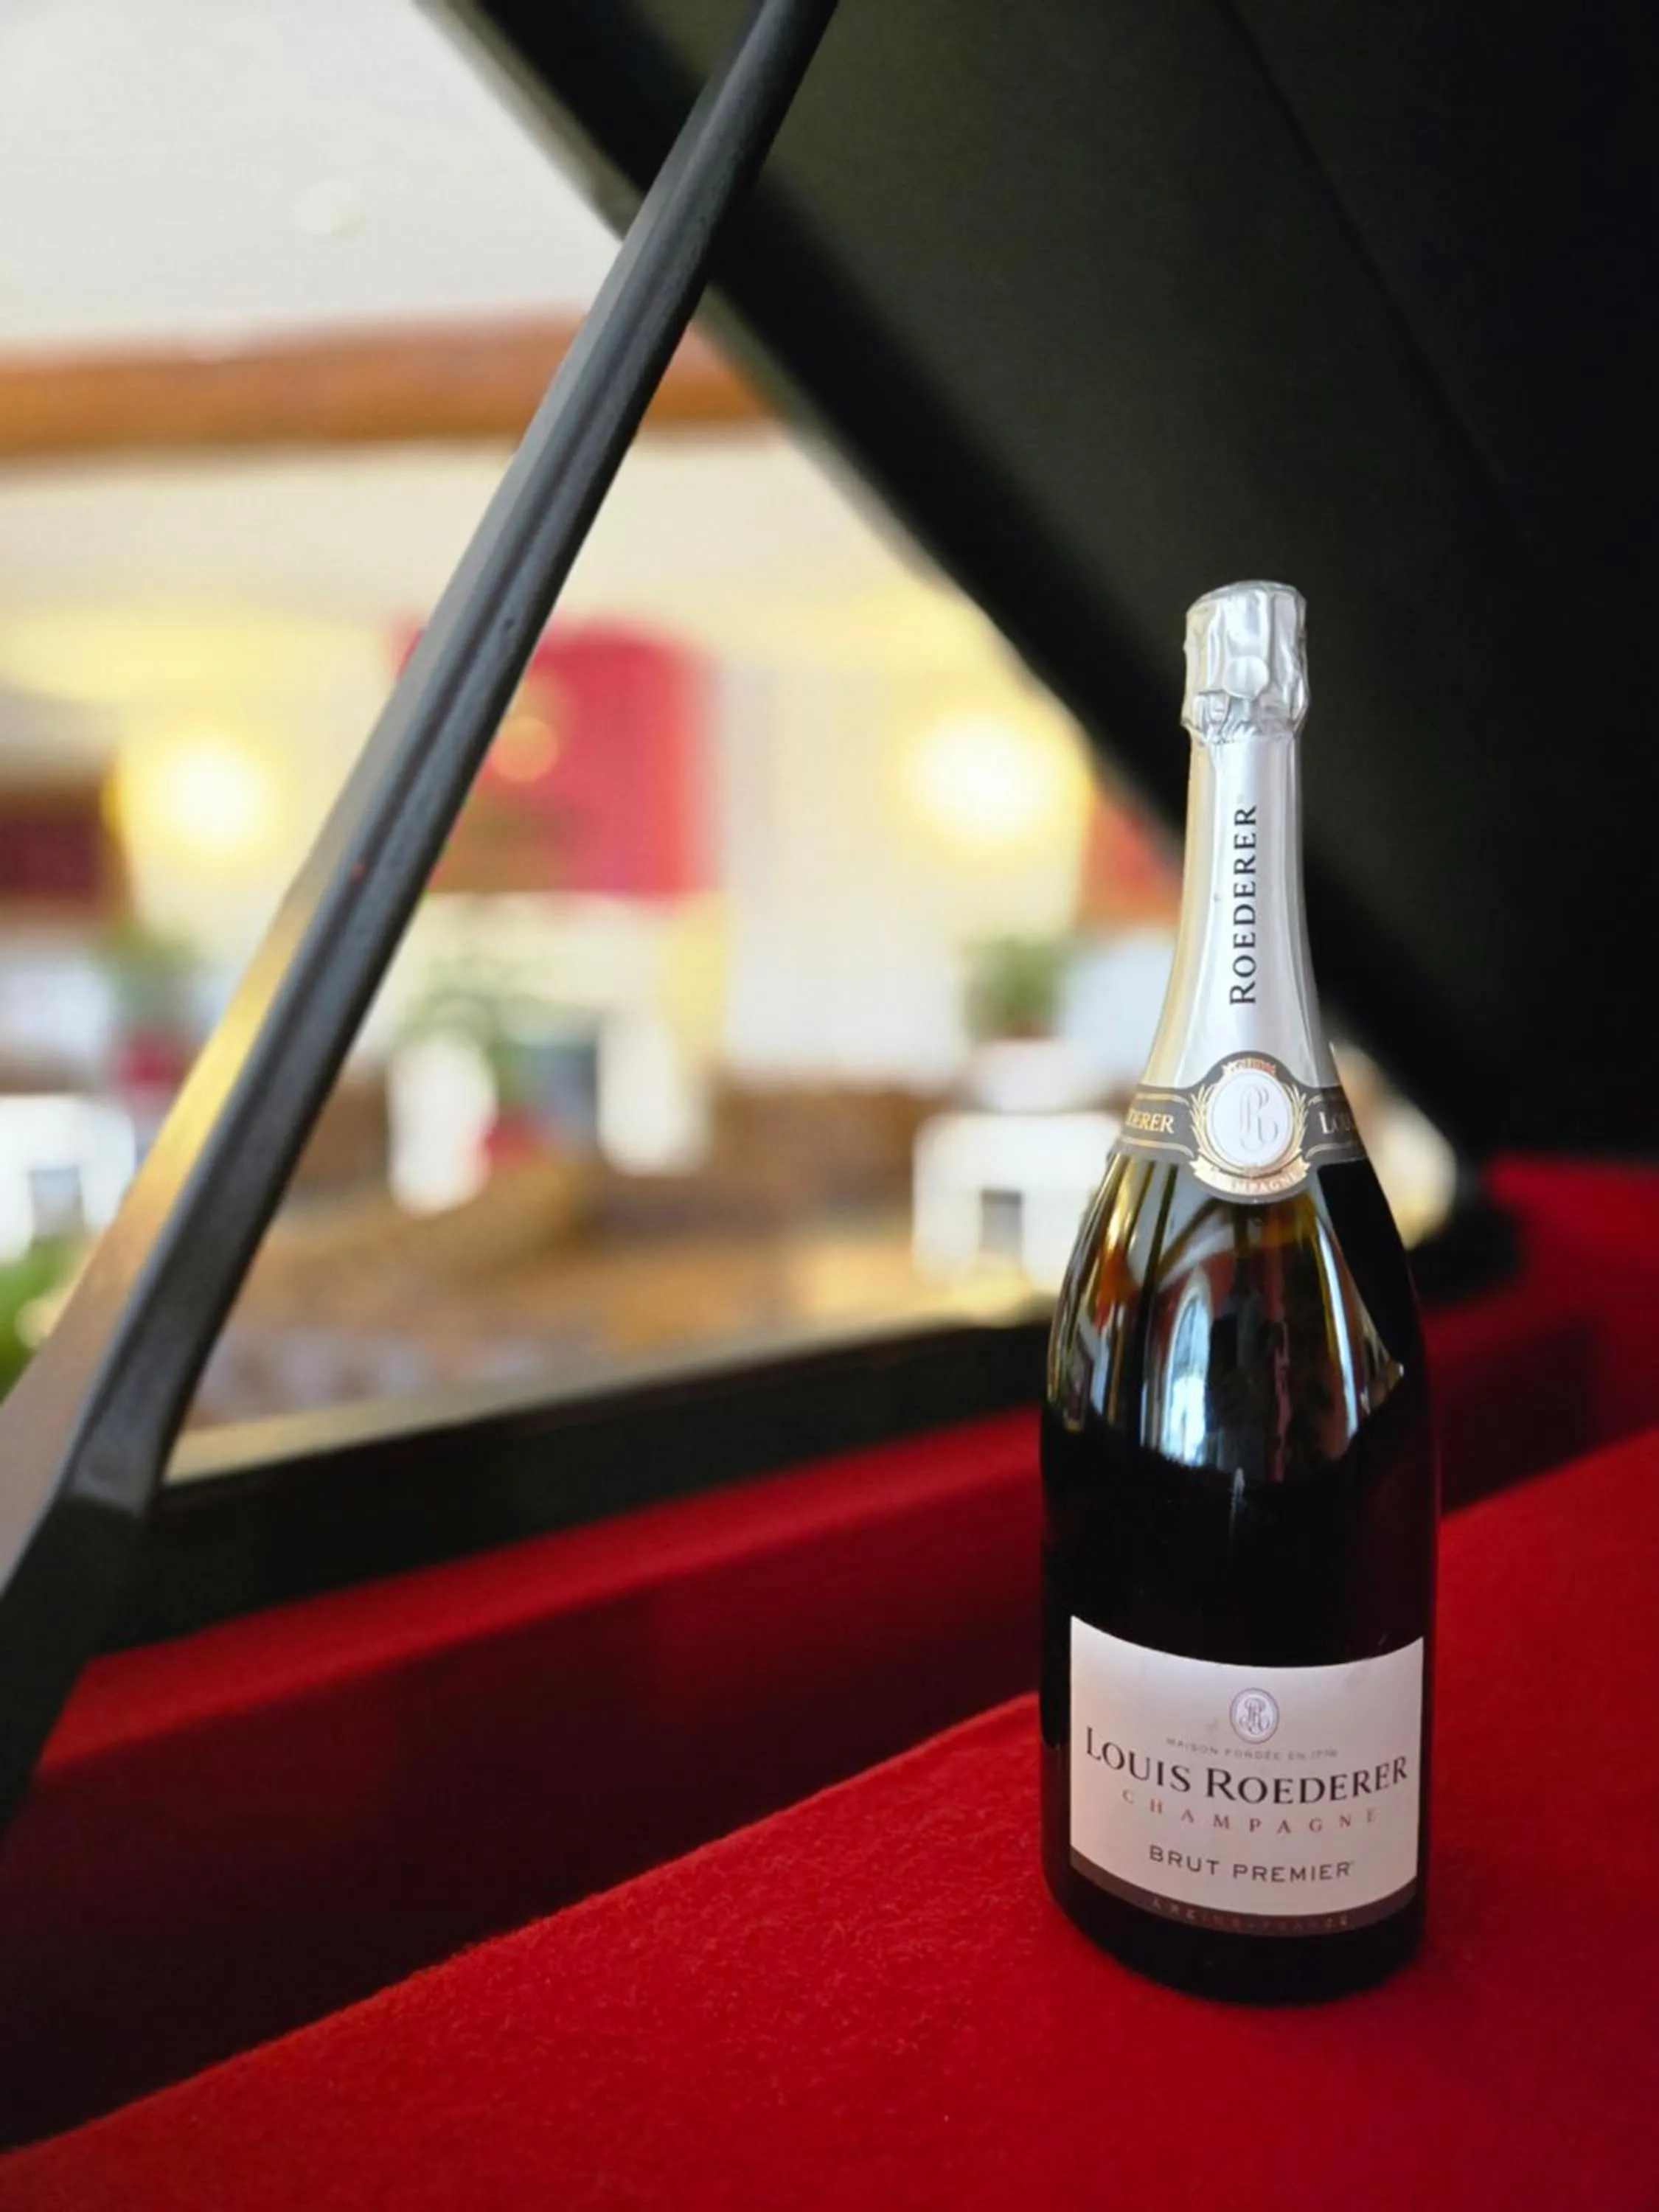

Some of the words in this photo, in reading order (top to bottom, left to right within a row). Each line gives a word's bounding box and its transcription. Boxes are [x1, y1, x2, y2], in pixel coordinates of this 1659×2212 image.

[1229, 805, 1256, 1006] ROEDERER
[1087, 1726, 1192, 1793] LOUIS
[1206, 1756, 1408, 1804] ROEDERER
[1122, 1789, 1377, 1834] CHAMPAGNE
[1149, 1844, 1220, 1875] BRUT
[1233, 1860, 1352, 1882] PREMIER
